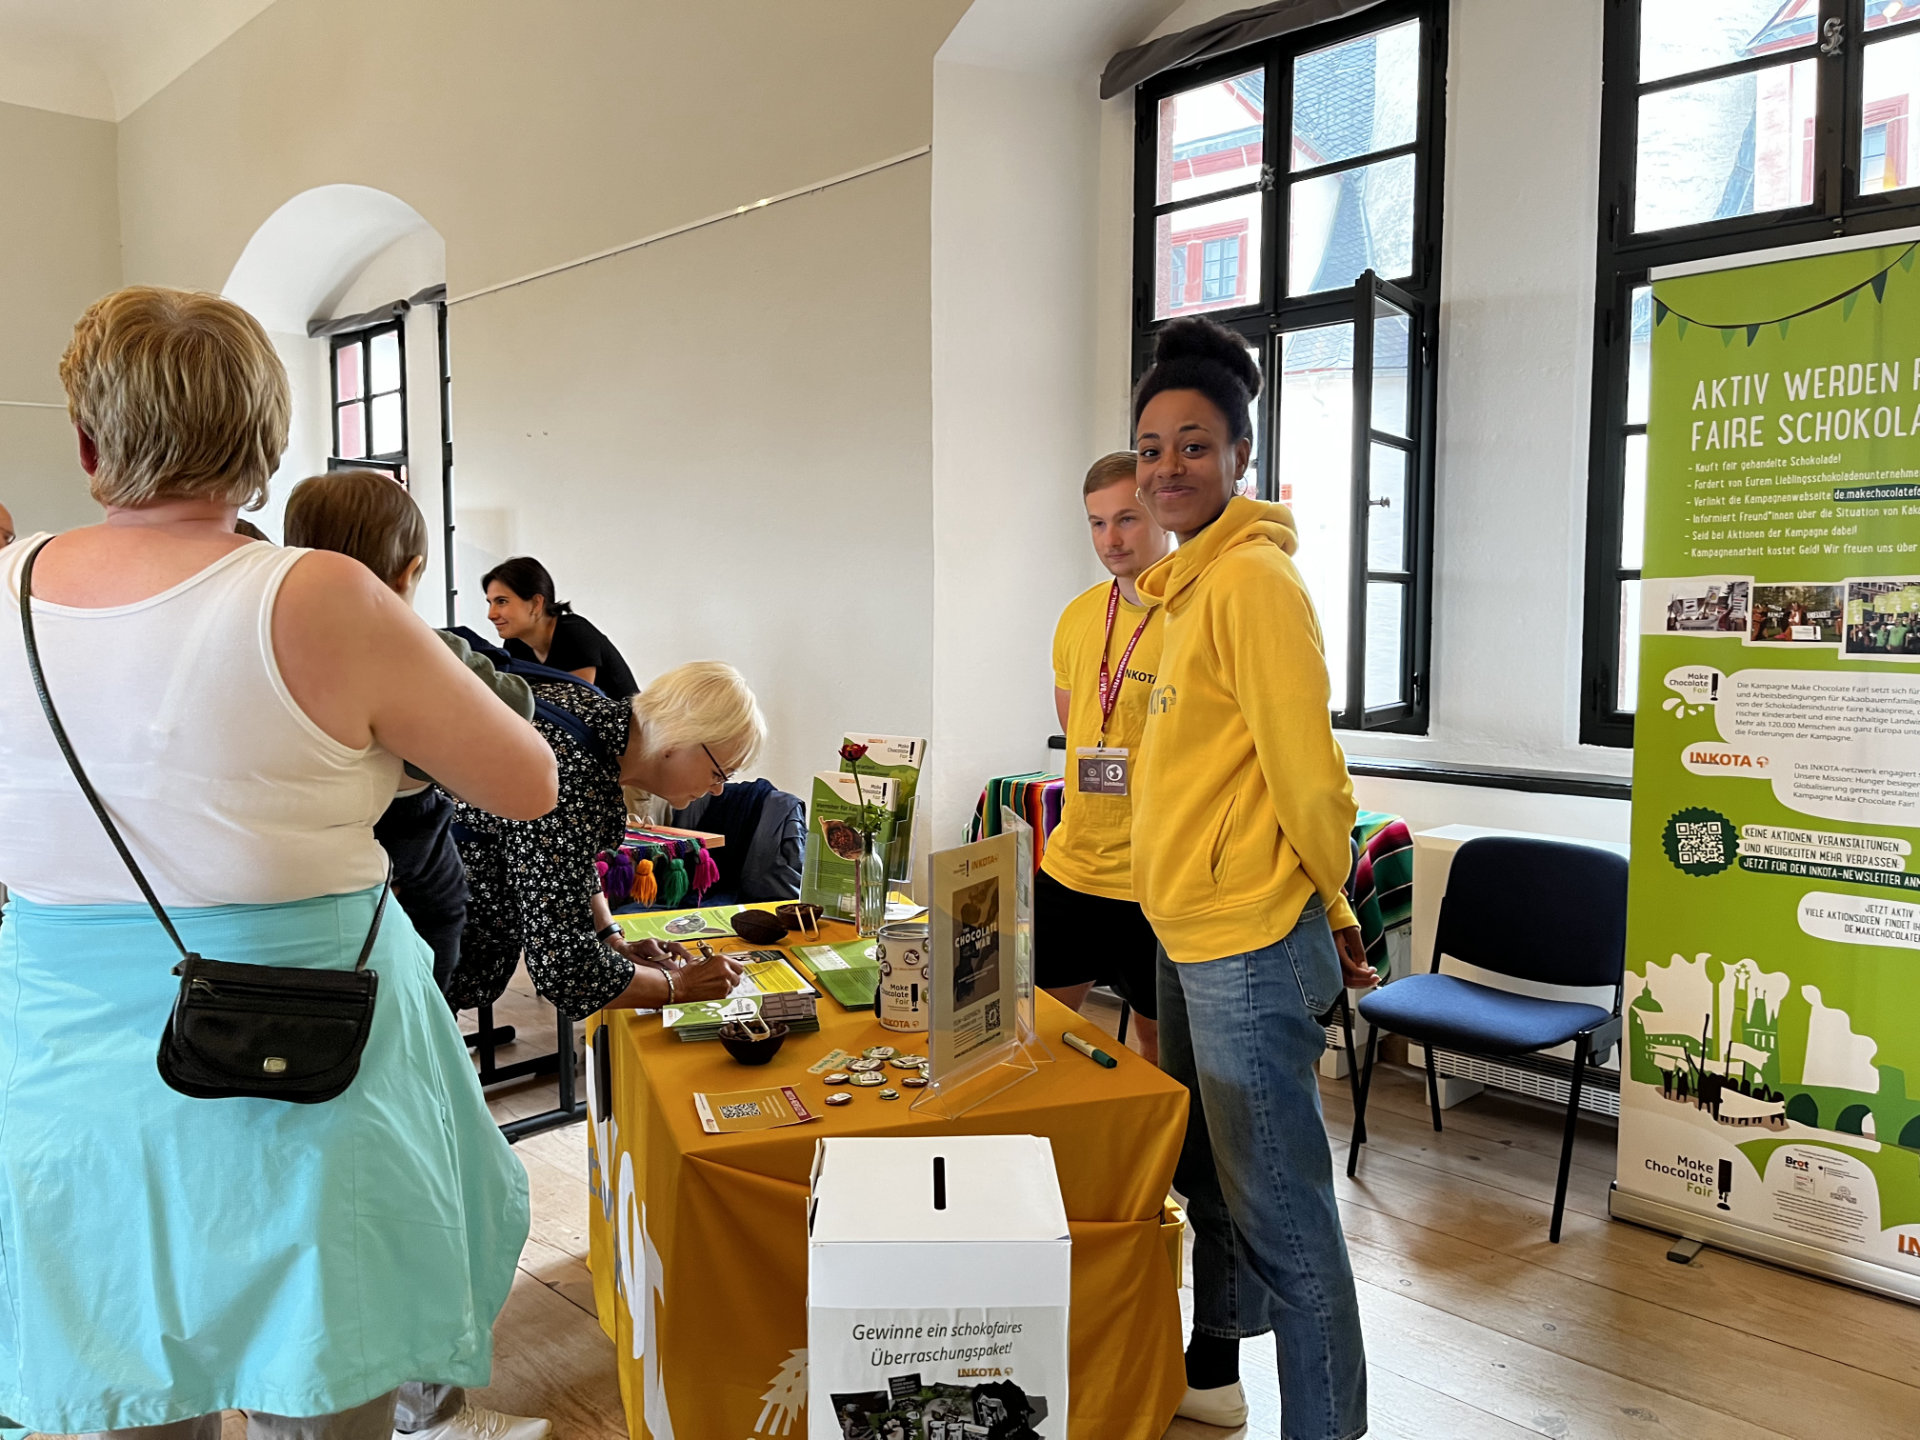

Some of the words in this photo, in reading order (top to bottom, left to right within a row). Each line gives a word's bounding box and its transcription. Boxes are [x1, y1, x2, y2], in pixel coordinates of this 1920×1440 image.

[1691, 372, 1770, 411] AKTIV
[1783, 361, 1899, 402] WERDEN
[1691, 415, 1764, 452] FAIRE
[1695, 462, 1719, 473] Kauft
[1722, 461, 1737, 471] fair
[1741, 458, 1787, 471] gehandelte
[1790, 453, 1841, 466] Schokolade!
[1694, 479, 1724, 489] Fordert
[1745, 476, 1772, 487] Eurem
[1694, 496, 1726, 507] Verlinkt
[1728, 495, 1742, 505] die
[1744, 491, 1831, 504] Kampagnenwebseite
[1692, 513, 1736, 523] Informiert
[1797, 509, 1817, 519] über
[1820, 508, 1833, 518] die
[1836, 507, 1879, 518] Situation
[1883, 508, 1898, 516] von
[1692, 530, 1709, 540] Seid
[1711, 530, 1724, 540] bei
[1727, 529, 1765, 539] Aktionen
[1767, 528, 1782, 538] der
[1785, 527, 1829, 539] Kampagne
[1831, 525, 1858, 536] dabei!
[1691, 546, 1764, 558] Kampagnenarbeit
[1767, 546, 1796, 555] kostet
[1798, 544, 1820, 555] Geld!
[1823, 543, 1840, 554] Wir
[1843, 543, 1874, 553] freuen
[1876, 544, 1894, 553] uns
[1896, 542, 1918, 552] über
[1125, 668, 1158, 685] NKOT
[1750, 682, 1789, 691] Kampagne
[1752, 692, 1827, 702] Arbeitsbedingungen
[1764, 702, 1844, 712] Schokoladenindustrie
[1762, 711, 1806, 719] Kinderarbeit
[1843, 716, 1889, 725] nachhaltige
[1747, 729, 1794, 739] Forderungen
[1810, 734, 1853, 742] Kampagne.
[1768, 721, 1796, 729] 120.000
[1797, 723, 1836, 731] Menschen
[1874, 726, 1902, 735] Europa
[1689, 751, 1752, 767] INKOTA
[1794, 762, 1809, 770] Das
[1810, 764, 1877, 775] INKOTA-netzwerk
[1878, 769, 1917, 778] engagiert
[1794, 772, 1820, 781] Unsere
[1822, 774, 1852, 783] Mission:
[1855, 777, 1885, 787] Hunger
[1793, 782, 1848, 793] Globalisierung
[1849, 786, 1879, 796] gerecht
[1793, 792, 1833, 802] Kampagne
[1835, 795, 1856, 803] Make
[1857, 796, 1896, 806] Chocolate
[1898, 799, 1915, 808] Fair!
[1744, 827, 1768, 839] KEINE
[1817, 834, 1899, 852] VERANSTALTUNGEN
[1744, 843, 1761, 853] UND
[1764, 844, 1817, 860] NEUIGKEITEN
[1819, 851, 1842, 863] MEHR
[1743, 858, 1769, 870] JETZT
[1771, 860, 1787, 872] FÜR
[1790, 863, 1807, 875] DEN
[1808, 865, 1901, 886] INKOTA-NEWSLETTER
[1805, 907, 1824, 918] VIELE
[1827, 911, 1880, 925] AKTIONSIDEEN
[1885, 918, 1910, 930] FINDET
[1865, 904, 1888, 915] JETZT
[1891, 907, 1914, 919] AKTIV
[954, 921, 998, 948] CHOCOLATE
[975, 936, 991, 950] WAR
[890, 983, 909, 991] Make
[1677, 1155, 1714, 1174] Make
[1785, 1156, 1809, 1169] Brot
[1645, 1159, 1713, 1186] Chocolate
[1687, 1182, 1713, 1198] Fair
[852, 1324, 923, 1340] Gewinne
[927, 1323, 948, 1338] ein
[951, 1321, 1023, 1338] schokofaires
[871, 1342, 1013, 1367] Überraschungspaket!
[958, 1367, 1002, 1378] INKOTA
